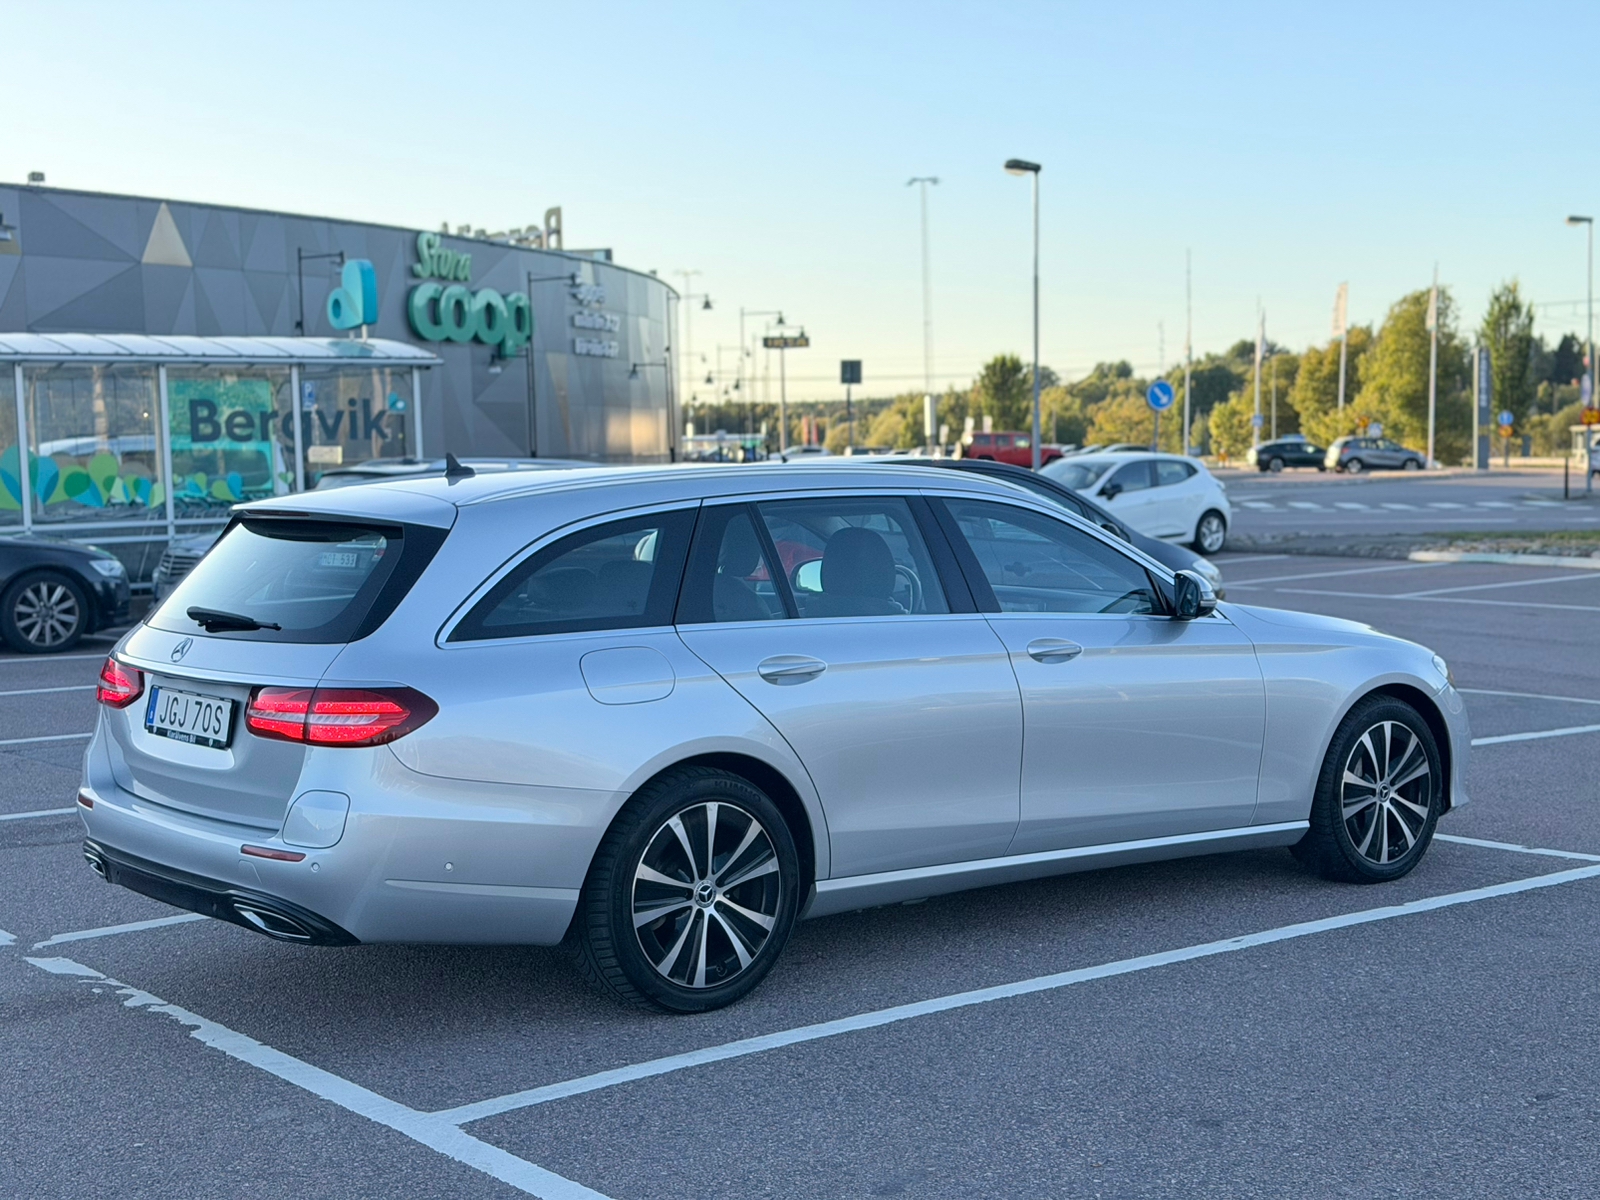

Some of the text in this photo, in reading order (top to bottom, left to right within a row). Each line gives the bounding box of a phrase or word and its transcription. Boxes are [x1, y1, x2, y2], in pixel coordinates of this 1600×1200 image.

[413, 232, 471, 281] Stora
[408, 282, 533, 357] coop
[189, 398, 388, 453] Bergvik
[159, 695, 189, 728] JGJ
[714, 780, 761, 802] KUMHO
